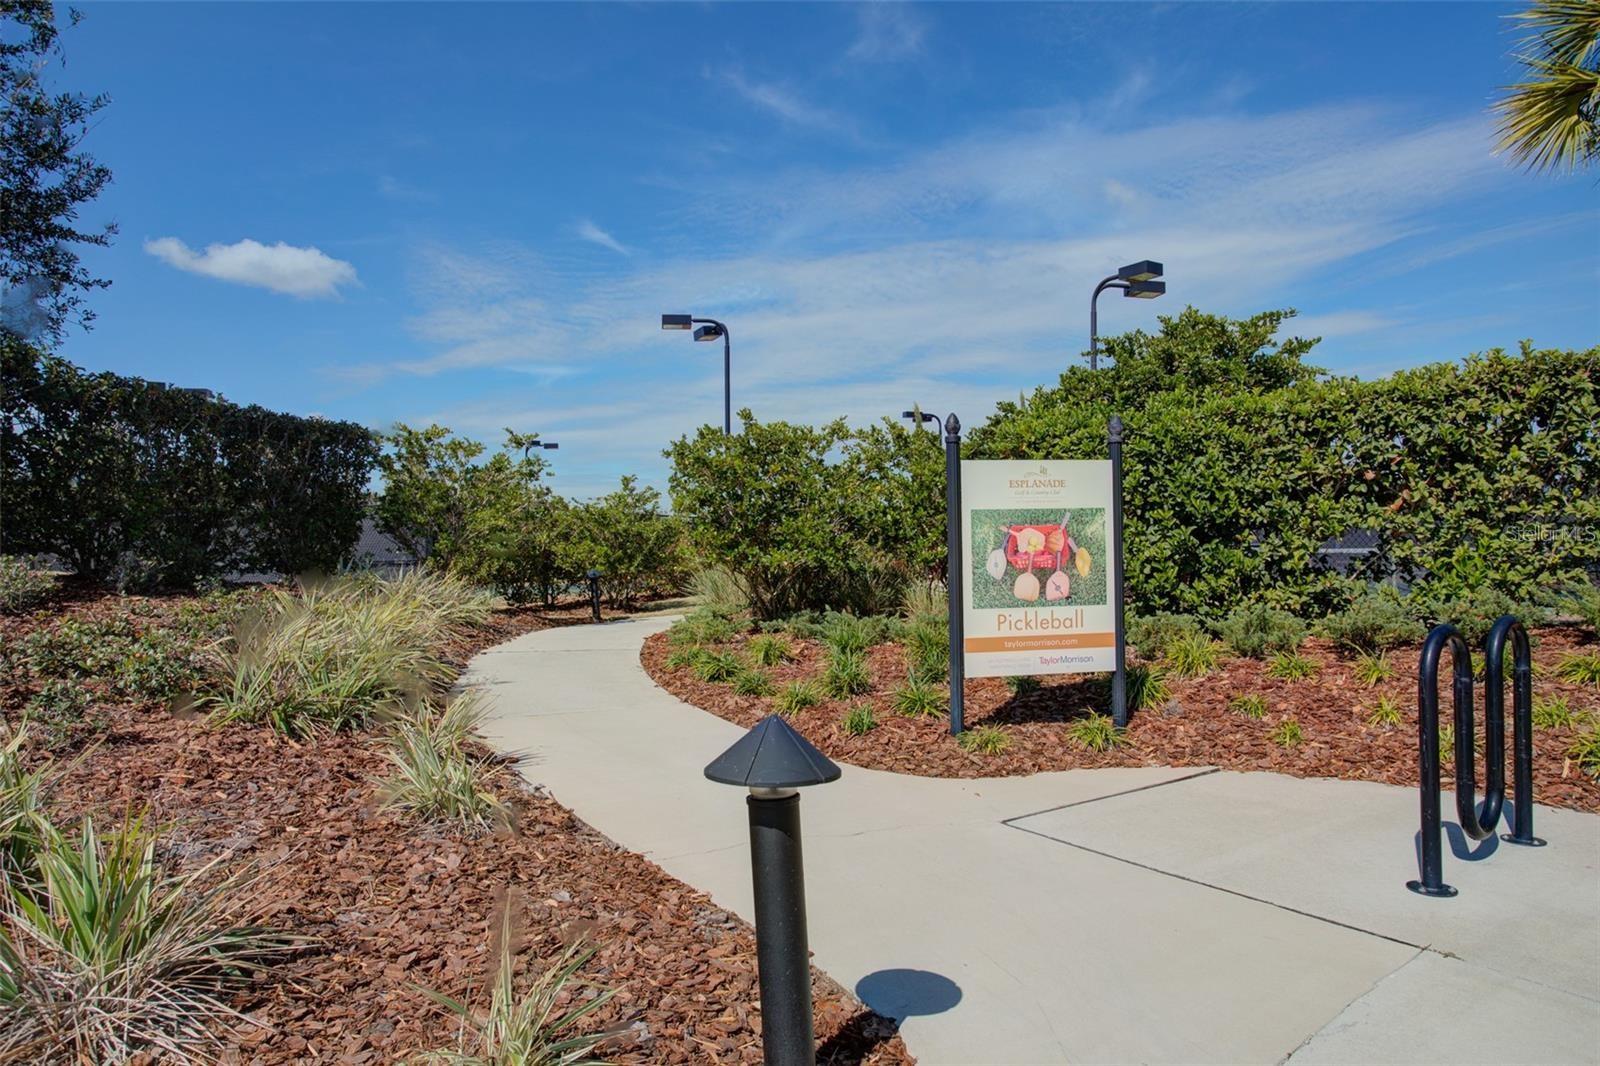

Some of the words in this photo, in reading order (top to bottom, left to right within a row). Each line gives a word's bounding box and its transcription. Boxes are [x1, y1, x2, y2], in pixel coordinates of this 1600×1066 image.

[1009, 479, 1066, 488] ESPLANADE
[997, 609, 1084, 631] Pickleball
[1004, 638, 1078, 649] taylormorrison.com
[1039, 655, 1094, 666] TaylorMorrison
